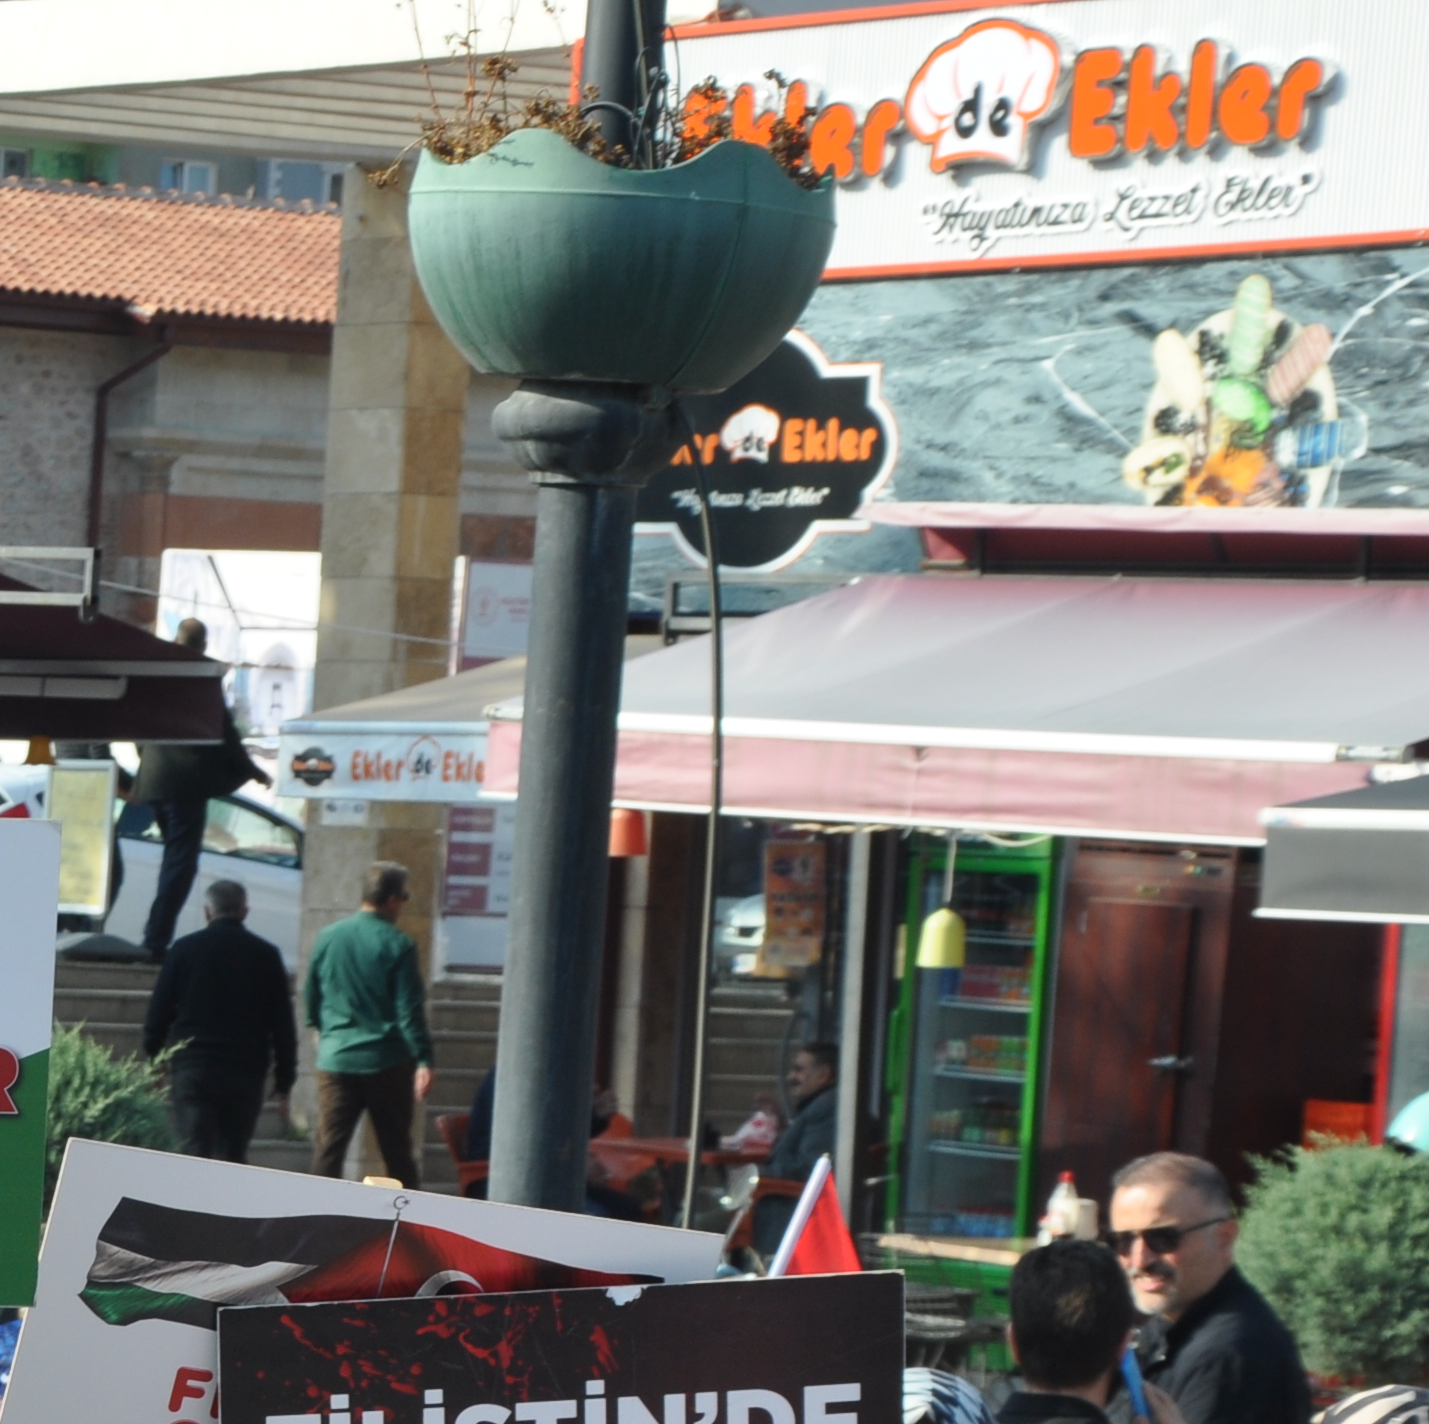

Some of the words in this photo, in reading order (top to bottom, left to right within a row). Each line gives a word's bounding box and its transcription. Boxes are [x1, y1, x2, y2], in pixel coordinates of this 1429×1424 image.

[954, 81, 1012, 139] de
[1068, 38, 1325, 158] Ekler
[1103, 183, 1202, 233] Lezzet
[781, 417, 879, 464] Ekler
[351, 751, 405, 782] Ekler
[442, 750, 485, 783] Ekle
